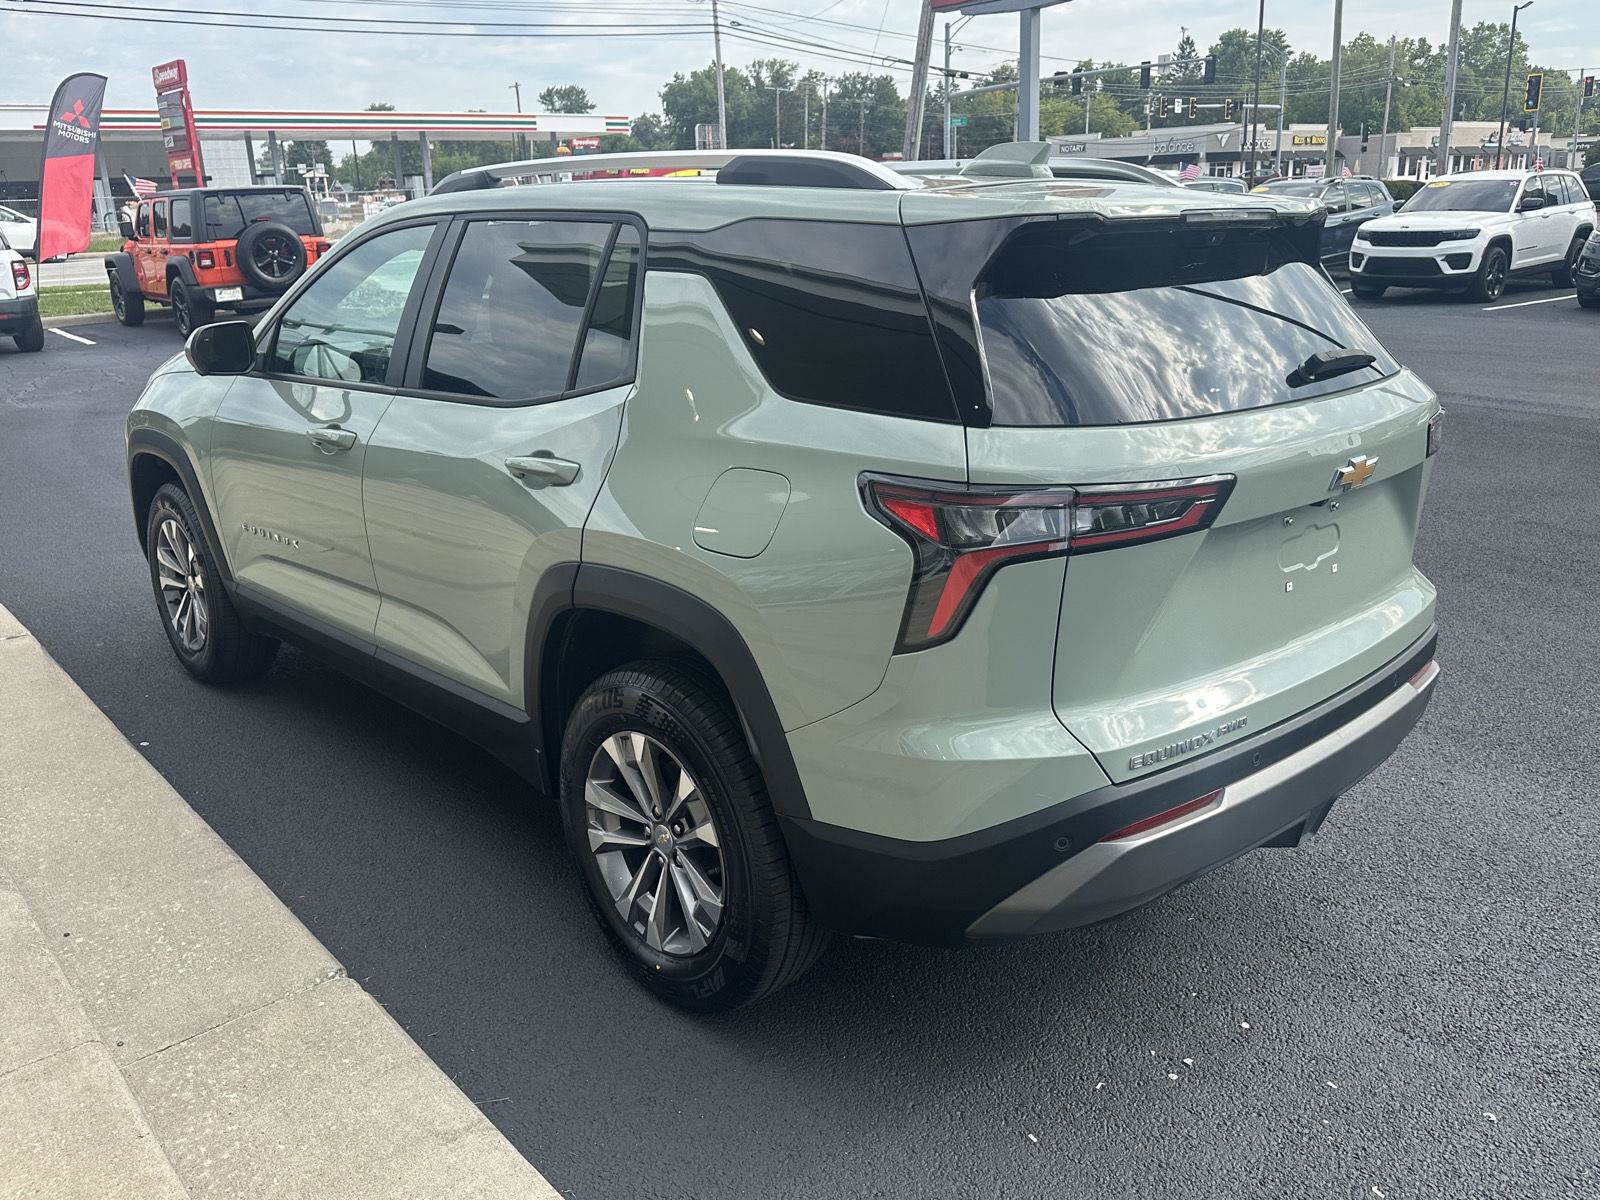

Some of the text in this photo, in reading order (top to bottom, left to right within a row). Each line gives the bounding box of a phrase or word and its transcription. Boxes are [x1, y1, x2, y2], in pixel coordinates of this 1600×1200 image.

[53, 119, 97, 138] MITSUBISHI
[57, 129, 90, 144] MOTORS
[1060, 144, 1085, 153] NOTARY
[241, 523, 300, 550] EQUINOX
[1129, 728, 1216, 770] EQUINOX
